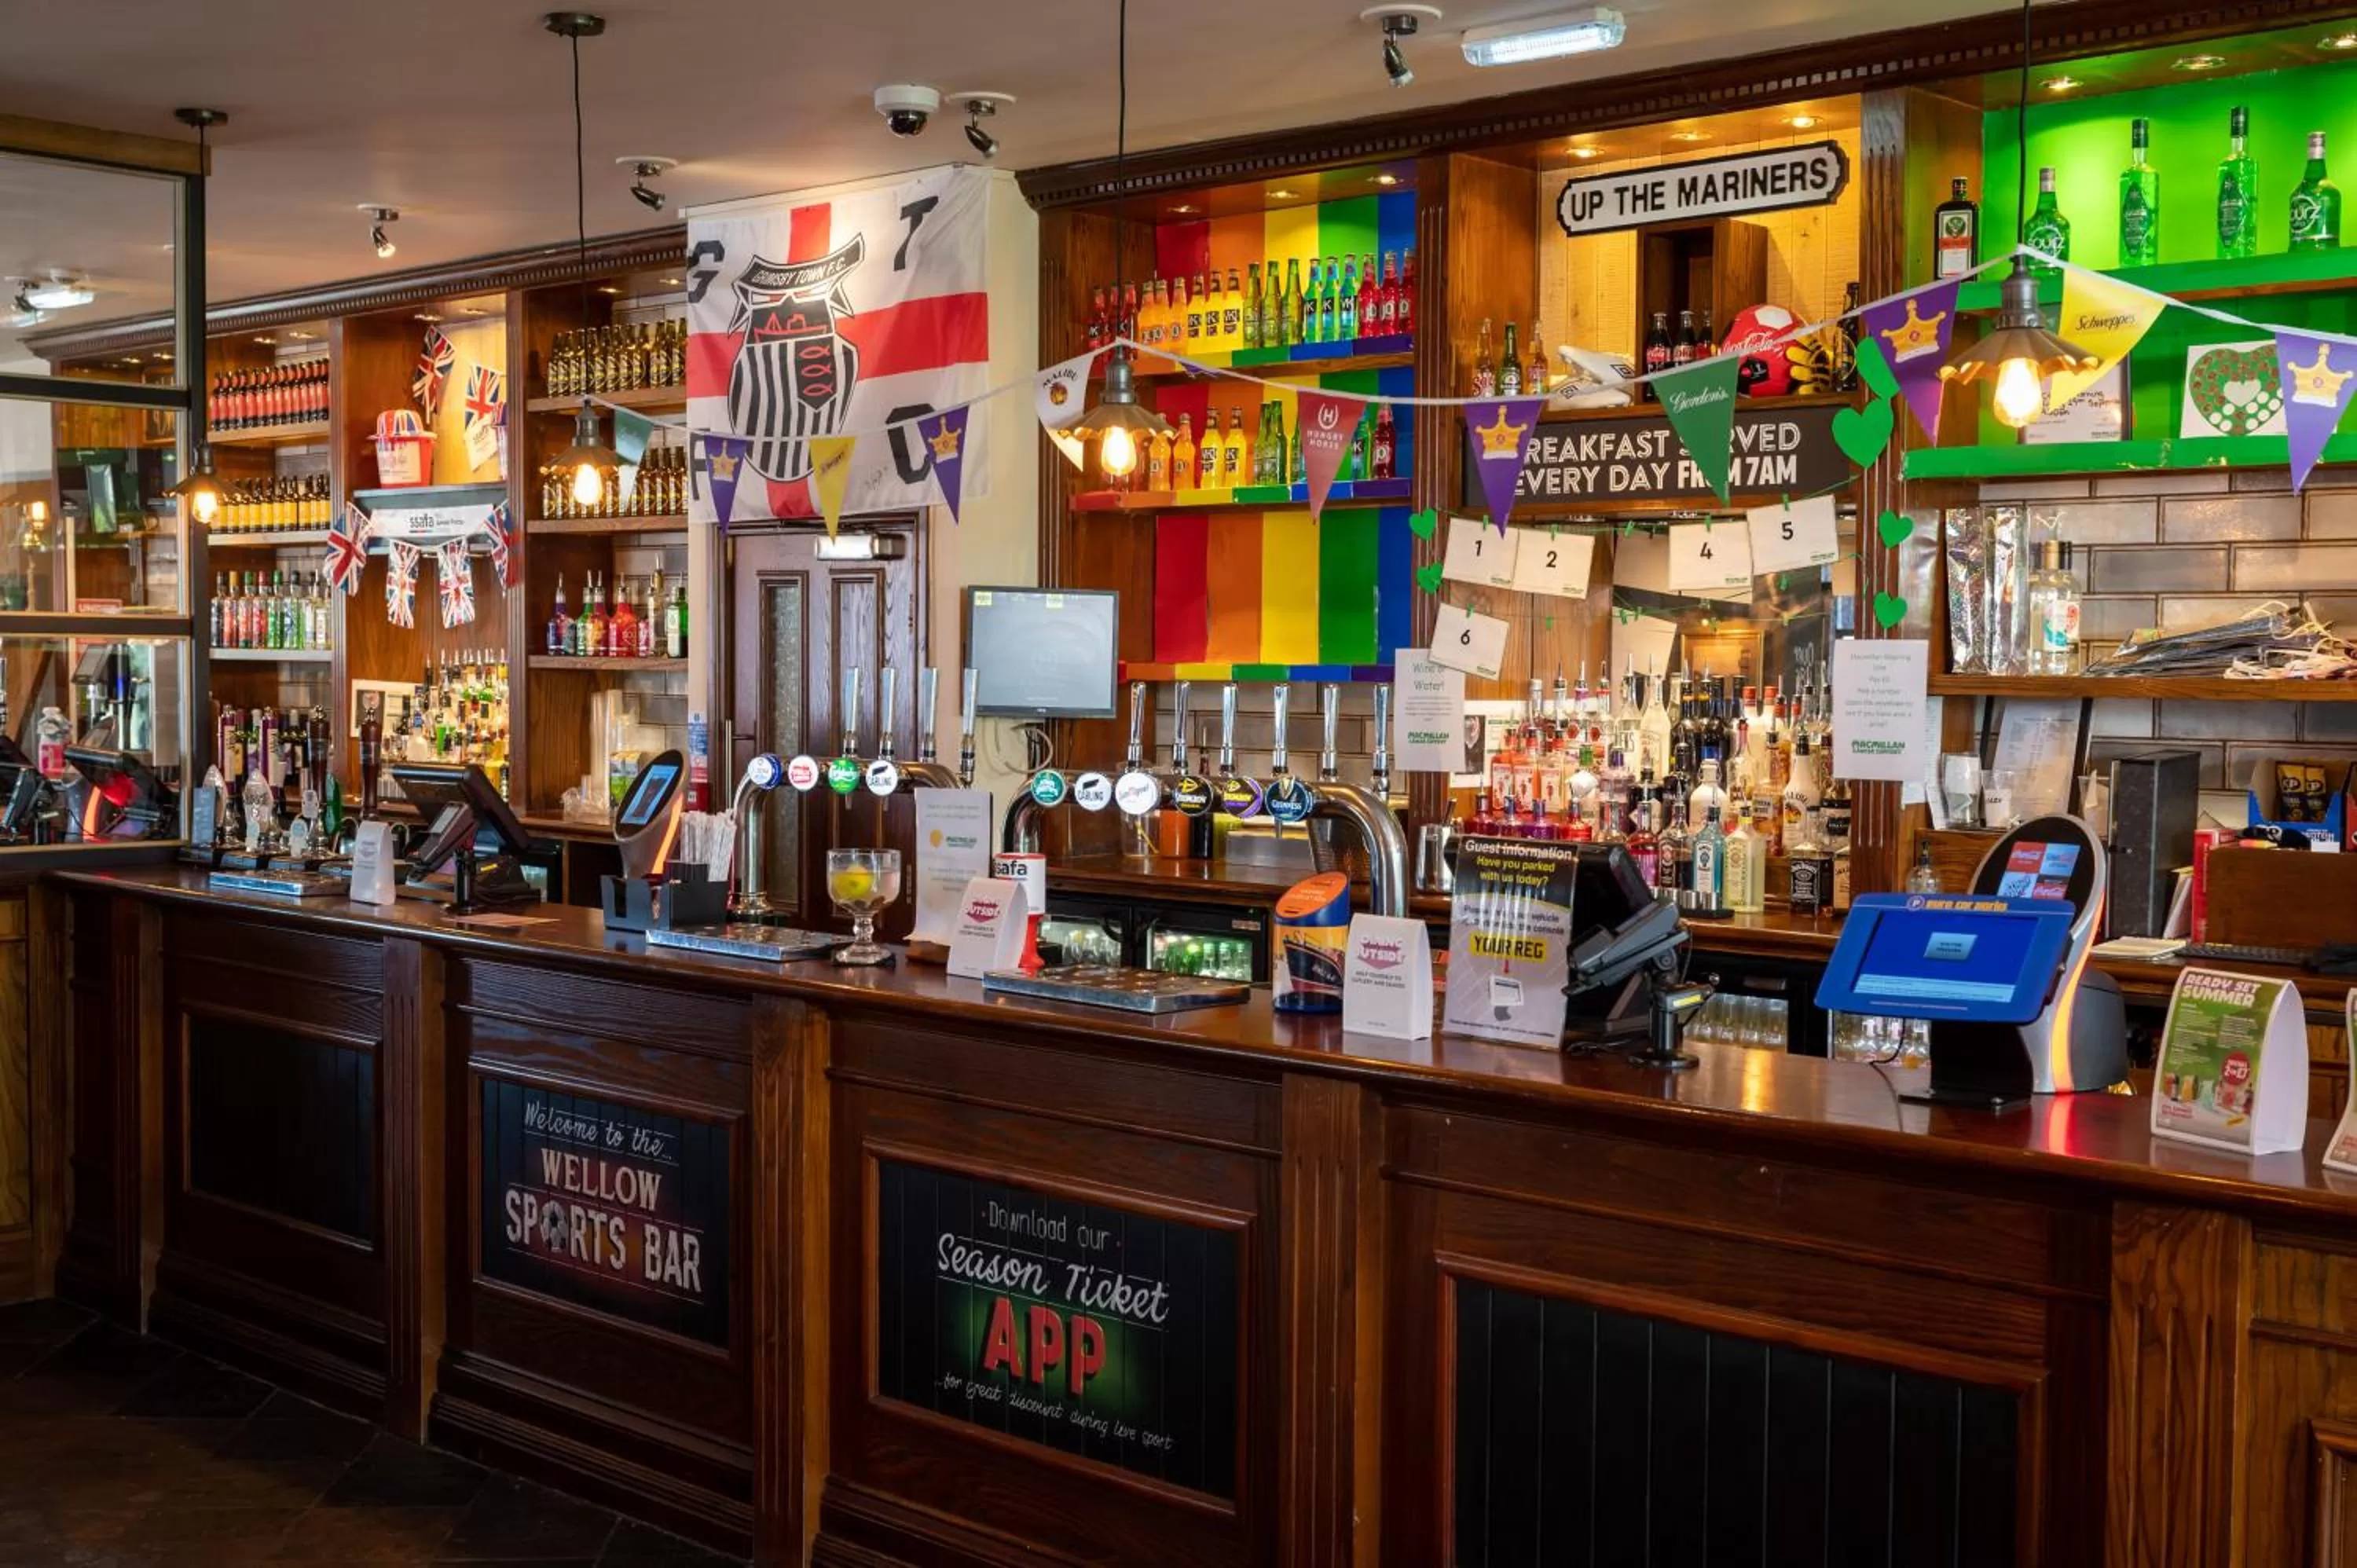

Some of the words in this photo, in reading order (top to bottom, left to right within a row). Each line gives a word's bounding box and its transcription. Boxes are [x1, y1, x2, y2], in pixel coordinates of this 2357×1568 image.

[1571, 192, 1604, 222] UP
[1614, 180, 1666, 215] THE
[1677, 157, 1830, 207] MARINERS
[687, 239, 725, 303] G
[893, 196, 939, 272] T
[794, 264, 827, 286] TOWN
[1669, 386, 1730, 414] Gordon's
[1523, 430, 1670, 465] REAKFAST
[1609, 461, 1671, 493] DAY
[1677, 456, 1741, 490] FRM
[1746, 454, 1797, 486] 7AM
[1781, 521, 1794, 540] 5
[1474, 540, 1483, 557] 1
[1545, 550, 1558, 568] 2
[1699, 541, 1713, 560] 4
[1460, 629, 1471, 646] 6
[1407, 731, 1450, 740] MACMILLAN
[1851, 738, 1905, 749] MACMILLAN
[1465, 839, 1501, 855] Guest
[1476, 855, 1501, 866] Have
[1502, 859, 1520, 870] you
[1522, 861, 1556, 873] parked
[1479, 870, 1499, 881] with
[1501, 874, 1513, 882] us
[1516, 874, 1549, 888] today?
[1474, 936, 1511, 956] YOUR
[1514, 940, 1544, 958] REG
[2181, 984, 2256, 1009] SUMMER
[2234, 980, 2263, 994] SET
[524, 1100, 599, 1141] Welcome
[605, 1121, 625, 1146] to
[541, 1147, 663, 1211] WELLOW
[988, 1200, 1067, 1243] Download
[1077, 1225, 1111, 1251] our
[505, 1189, 627, 1270] SPORTS
[643, 1222, 702, 1292] BAR
[937, 1232, 1051, 1295] Season
[1065, 1262, 1170, 1324] Ticket
[984, 1295, 1108, 1396] APP
[965, 1381, 1003, 1401] great
[1009, 1391, 1064, 1419] discount
[1069, 1411, 1109, 1435] during
[1142, 1431, 1176, 1451] sport
